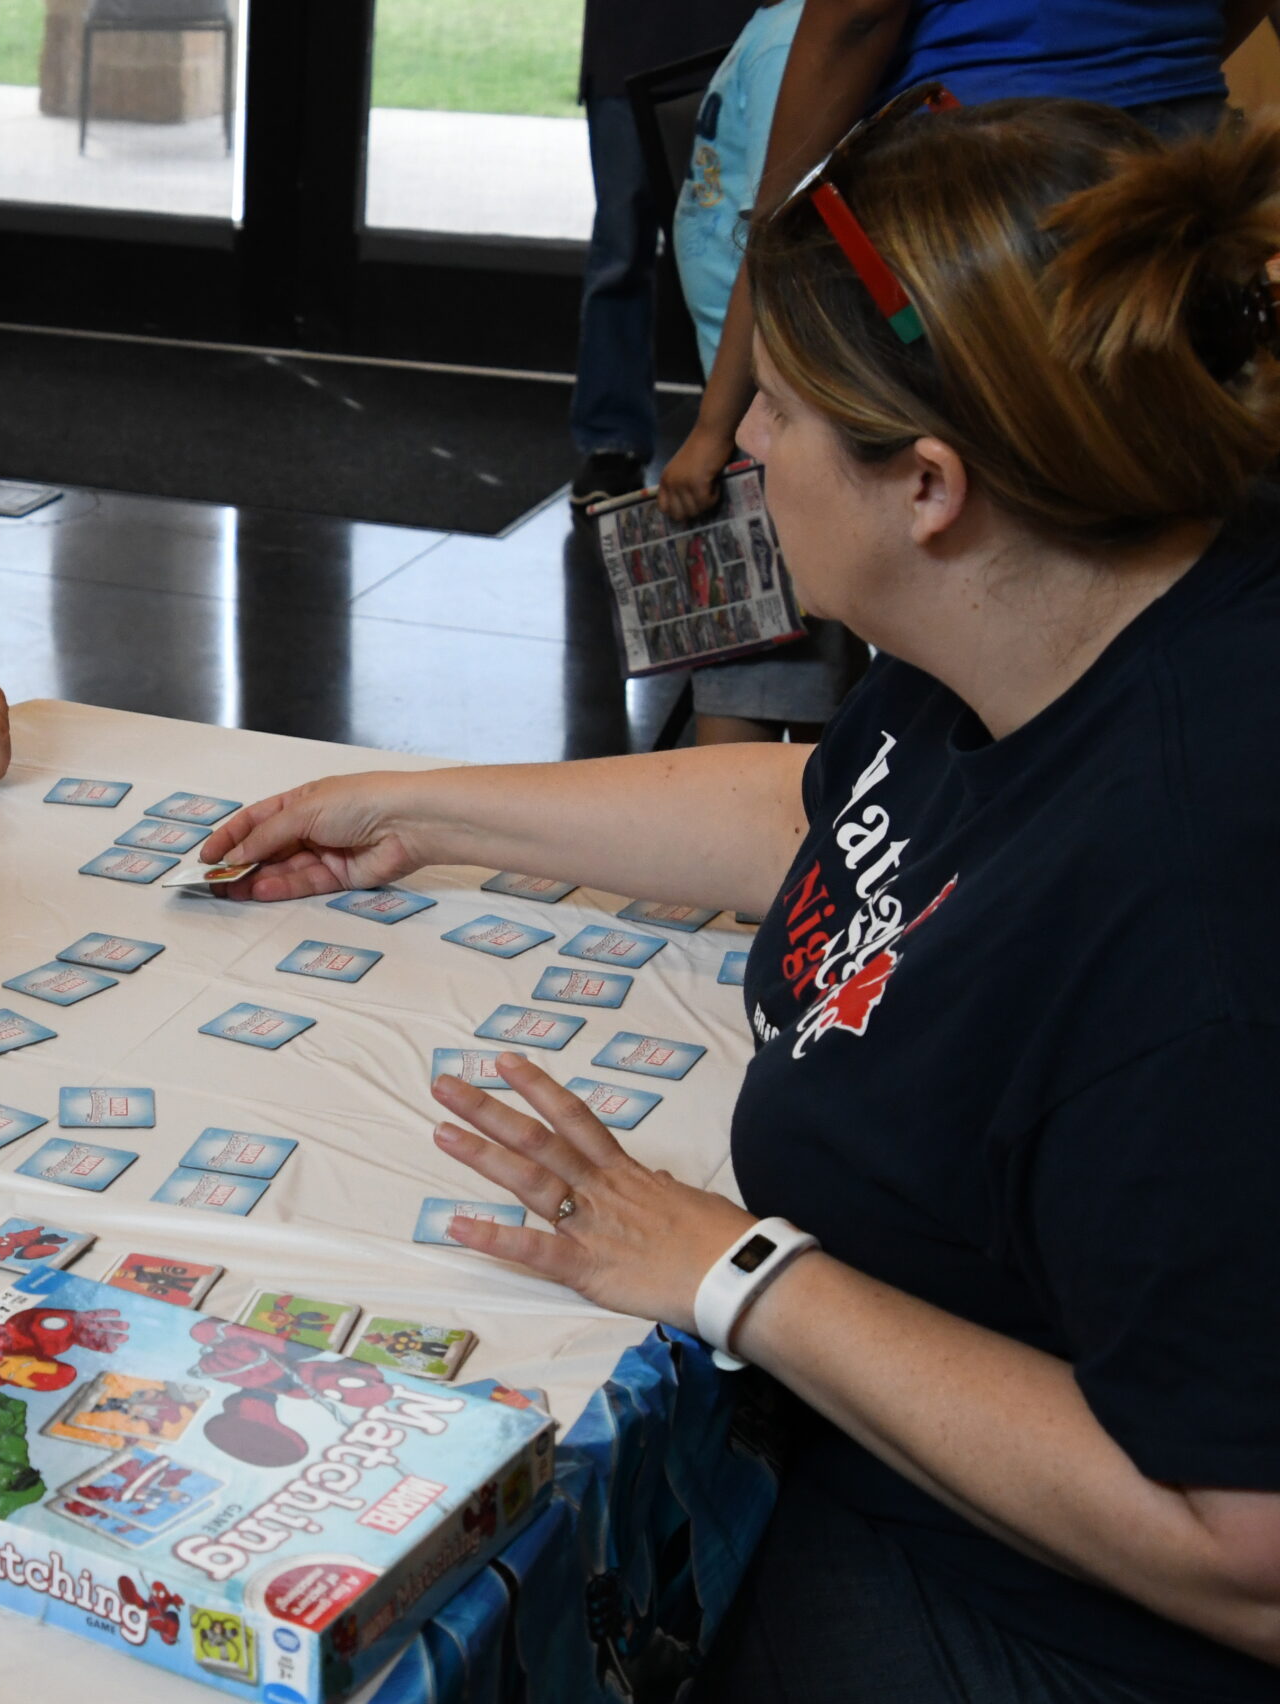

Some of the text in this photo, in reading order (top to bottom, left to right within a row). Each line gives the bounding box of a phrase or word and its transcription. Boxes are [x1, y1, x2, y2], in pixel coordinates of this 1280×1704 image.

[172, 1384, 466, 1582] Matching
[359, 1476, 446, 1533] MARVEL
[202, 1503, 242, 1534] GAME
[85, 1616, 117, 1636] GAME
